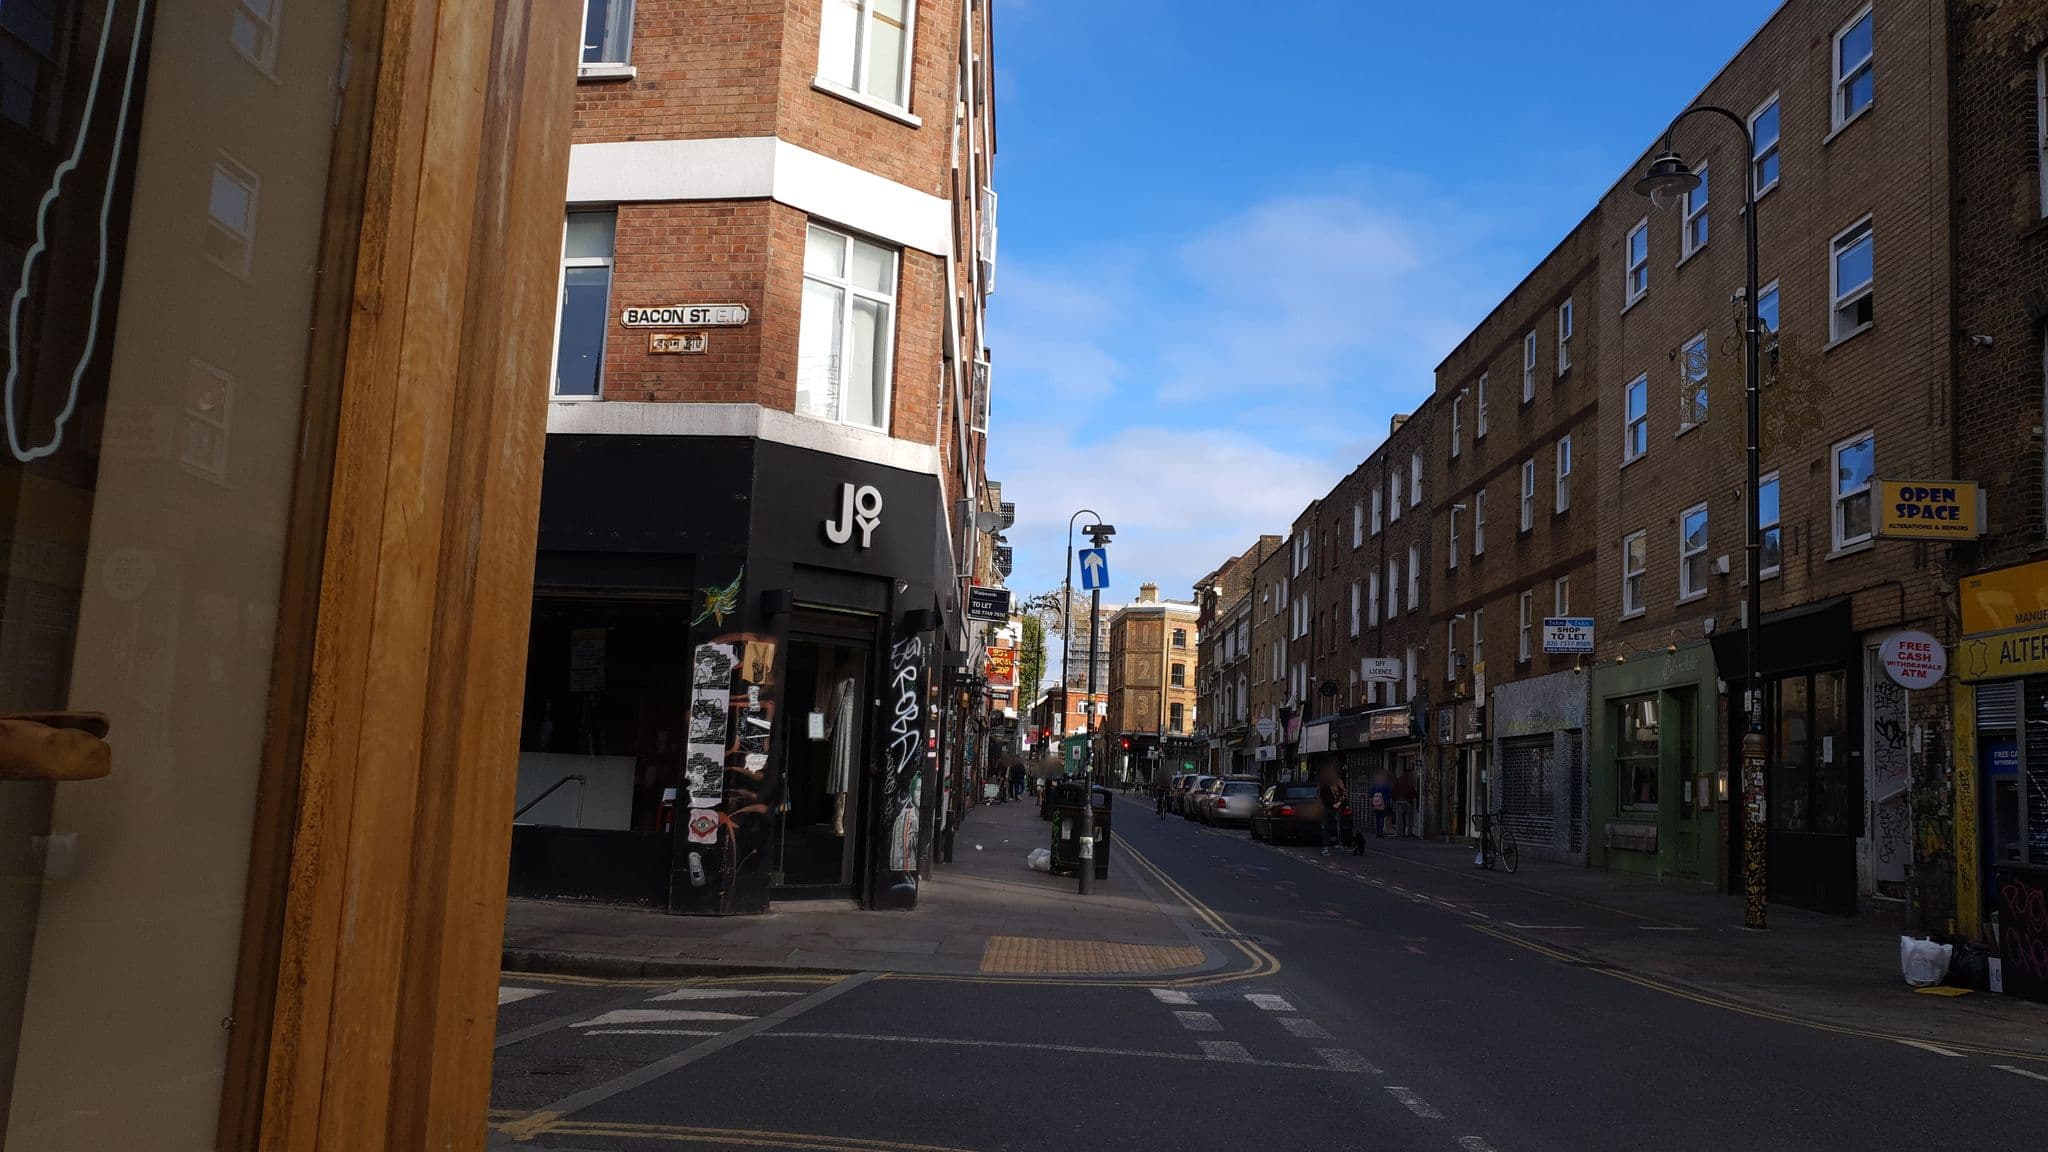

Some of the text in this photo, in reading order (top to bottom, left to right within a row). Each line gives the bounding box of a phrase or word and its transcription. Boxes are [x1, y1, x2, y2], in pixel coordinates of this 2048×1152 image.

[628, 309, 684, 323] BACON
[690, 309, 711, 323] ST.
[1900, 486, 1955, 503] OPEN
[825, 482, 883, 548] JOY
[1895, 503, 1960, 521] SPACE
[1899, 641, 1931, 652] FREE
[1897, 651, 1932, 663] CASH
[1137, 659, 1151, 680] 2
[1886, 660, 1943, 671] WITHDRAWALS
[1901, 668, 1927, 679] ATM
[1136, 695, 1149, 715] 3
[1993, 751, 2009, 759] FREE
